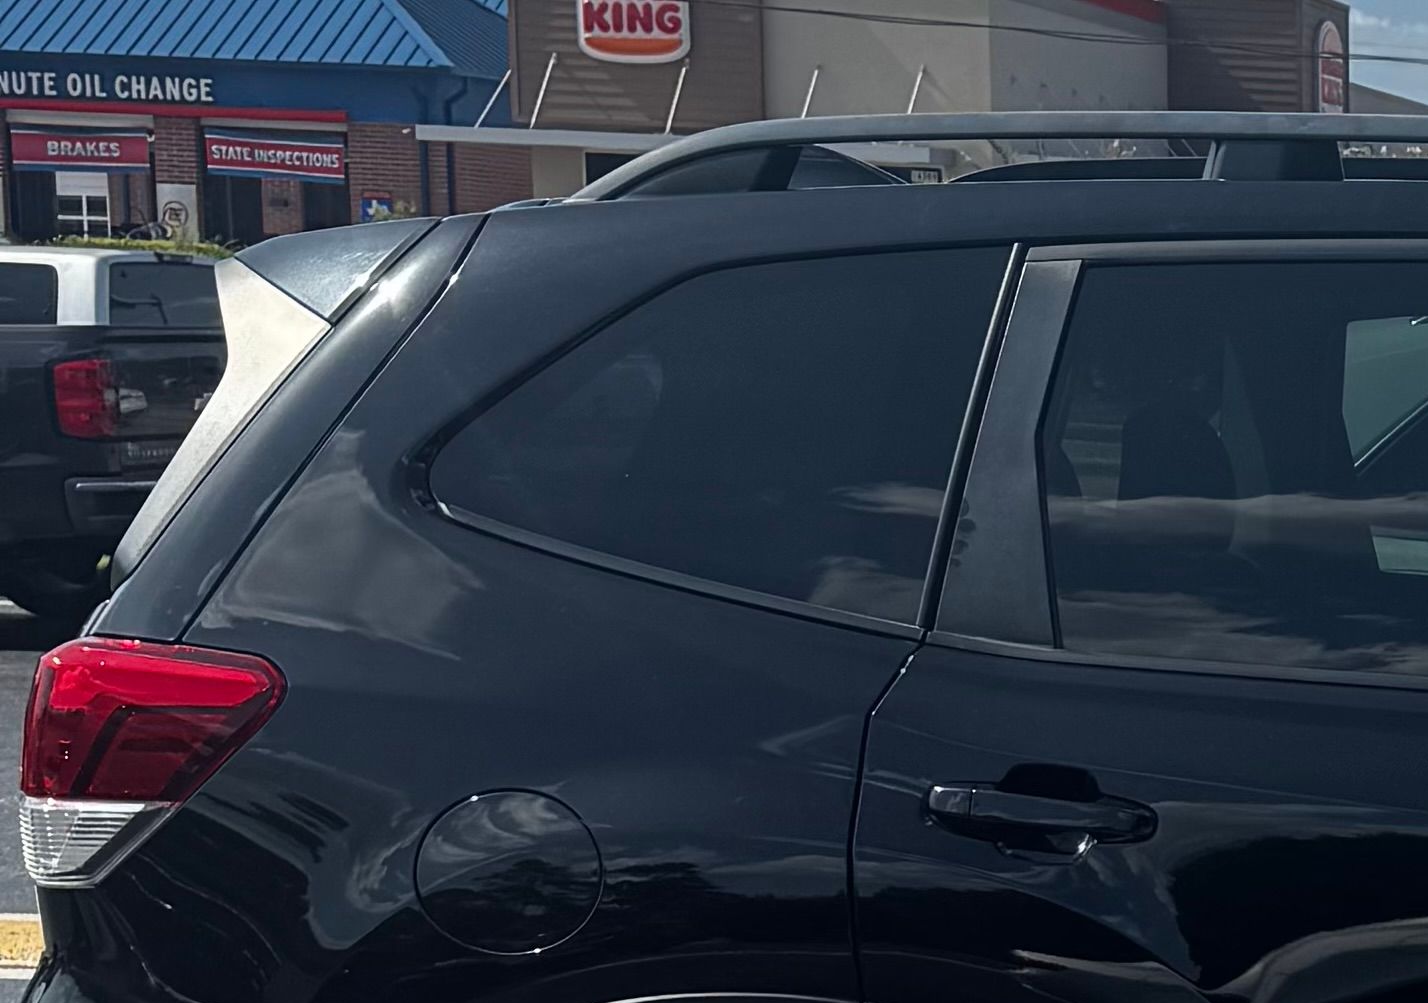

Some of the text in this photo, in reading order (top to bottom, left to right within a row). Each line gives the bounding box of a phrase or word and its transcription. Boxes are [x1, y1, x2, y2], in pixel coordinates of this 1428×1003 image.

[583, 2, 682, 34] KING
[67, 73, 107, 97] OIL
[115, 75, 214, 102] CHANGE
[47, 141, 120, 157] BRAKES
[211, 145, 340, 168] STATE INSPECTIONS
